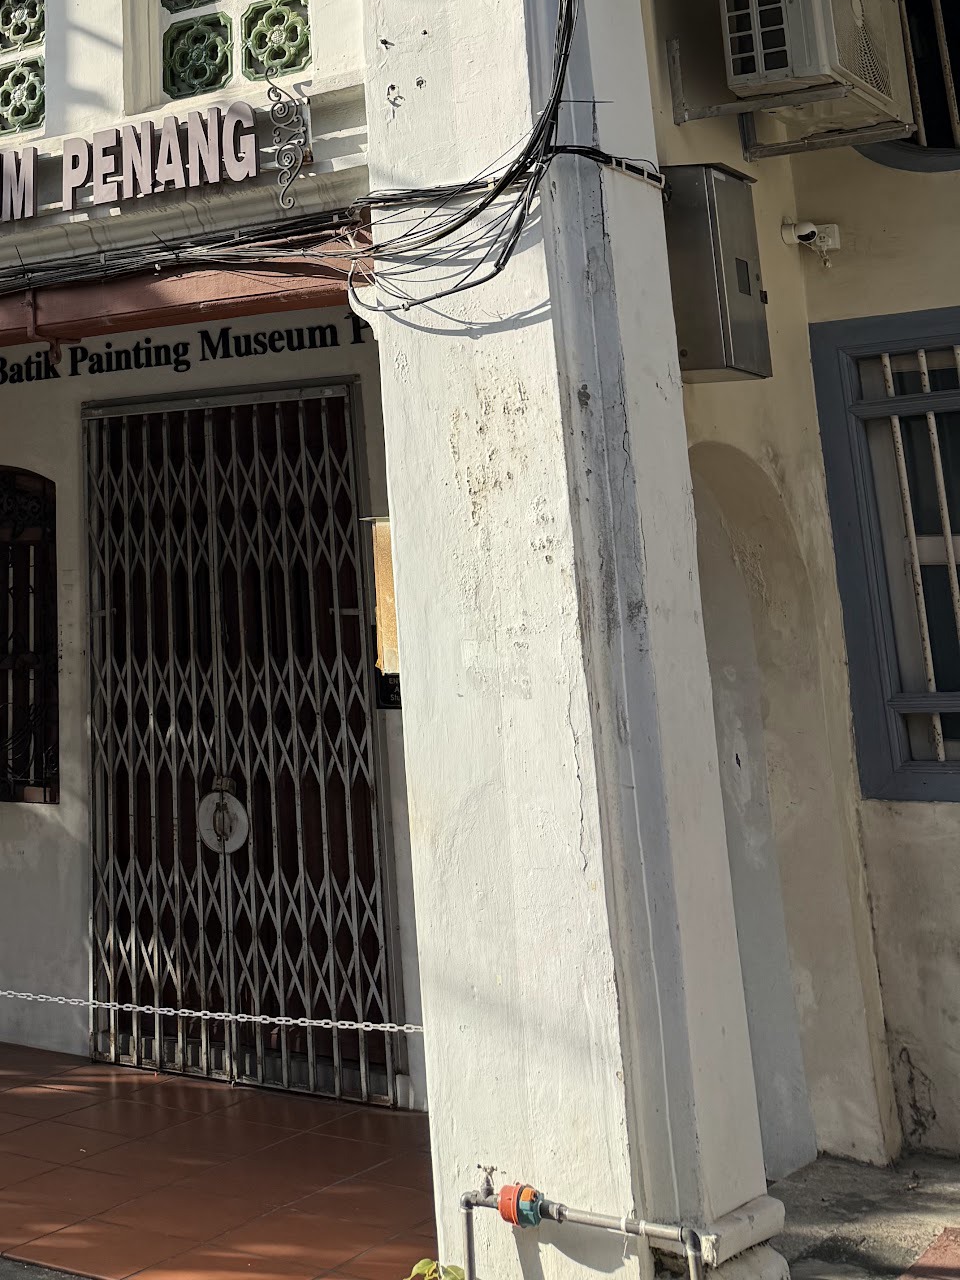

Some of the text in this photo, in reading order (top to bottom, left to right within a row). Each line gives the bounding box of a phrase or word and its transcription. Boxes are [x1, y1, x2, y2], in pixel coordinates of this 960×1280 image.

[62, 101, 261, 211] PENANG
[68, 338, 191, 377] Painting
[198, 322, 341, 362] Museum
